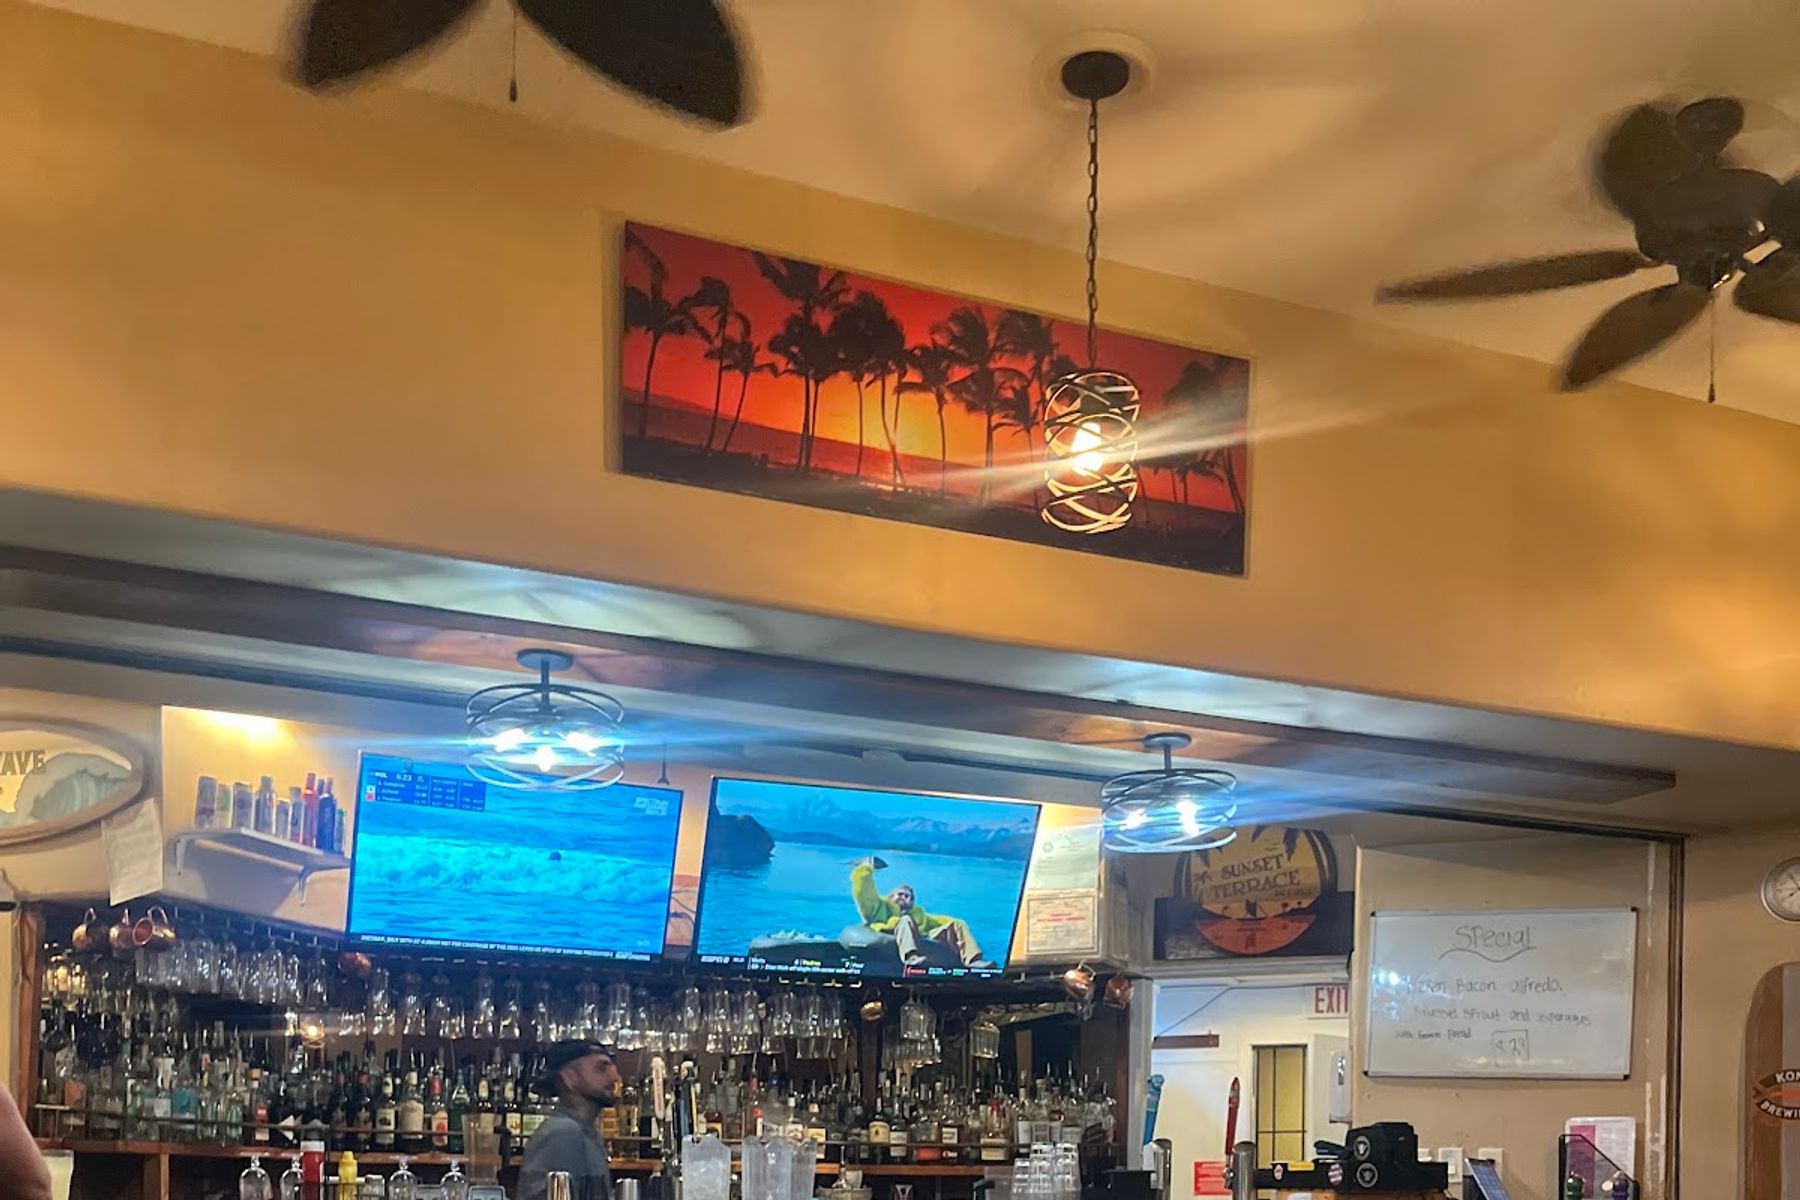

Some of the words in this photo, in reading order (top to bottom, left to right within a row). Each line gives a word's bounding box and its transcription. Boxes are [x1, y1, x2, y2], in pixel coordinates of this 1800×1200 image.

[1221, 854, 1284, 880] SUNSET
[1212, 869, 1299, 899] TERRACE
[1315, 986, 1348, 1013] EXIT
[1760, 1100, 1800, 1118] BREWI
